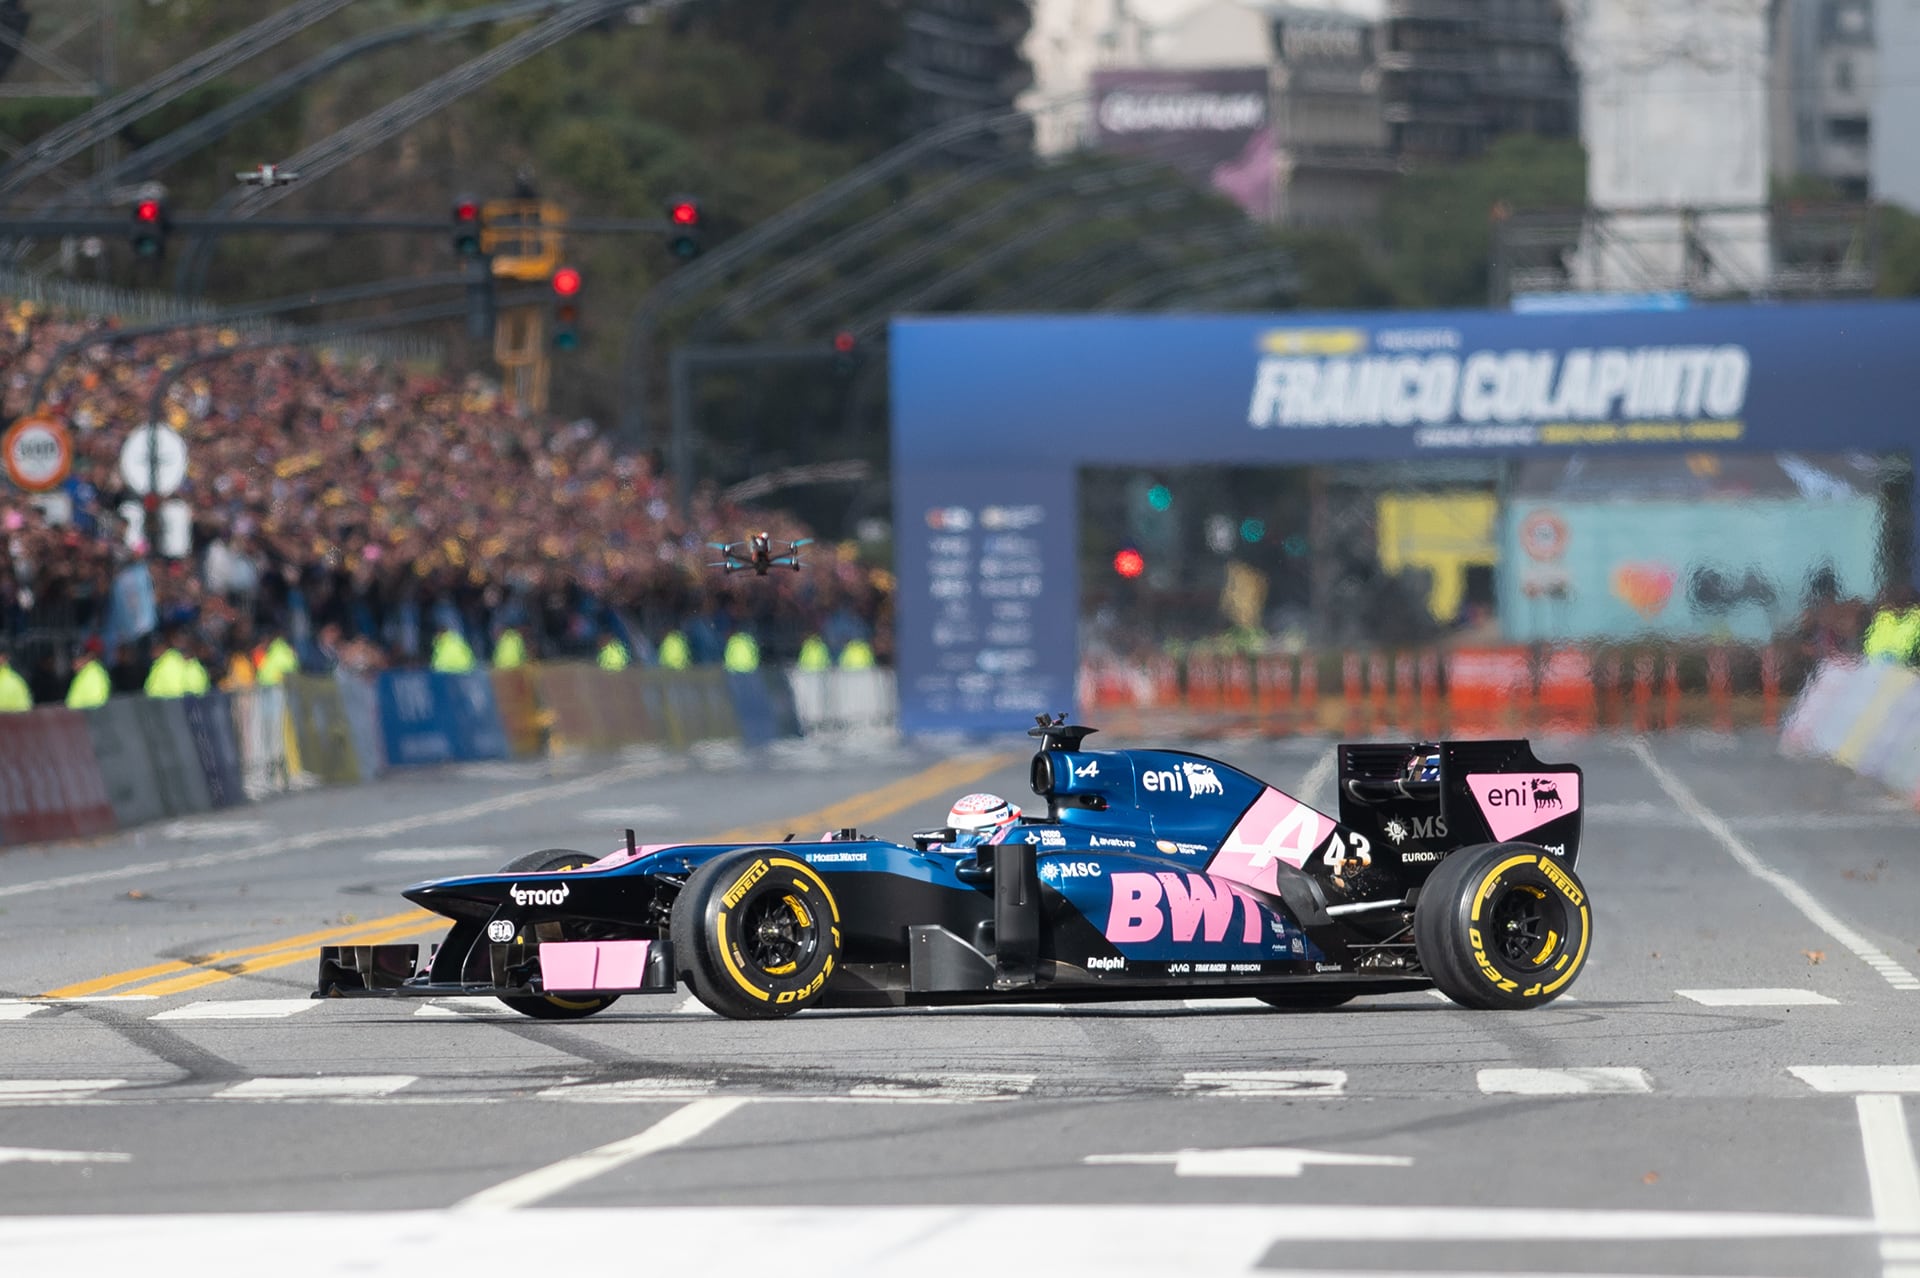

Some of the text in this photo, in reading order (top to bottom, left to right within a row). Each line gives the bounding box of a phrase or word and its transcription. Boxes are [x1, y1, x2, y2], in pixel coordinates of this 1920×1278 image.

[1250, 345, 1749, 427] FRANCO COLAPINTO
[1142, 764, 1184, 792] eni
[1488, 781, 1527, 806] eni
[1059, 862, 1102, 877] MSC
[1323, 831, 1372, 876] 43
[721, 858, 770, 910] PIRELLI
[1537, 855, 1584, 907] PIRELLI
[1105, 872, 1262, 943] BWT
[775, 954, 835, 1004] ZERO
[1087, 956, 1125, 971] Delphi
[1231, 964, 1261, 972] MISSION
[1469, 927, 1519, 993] ZERO
